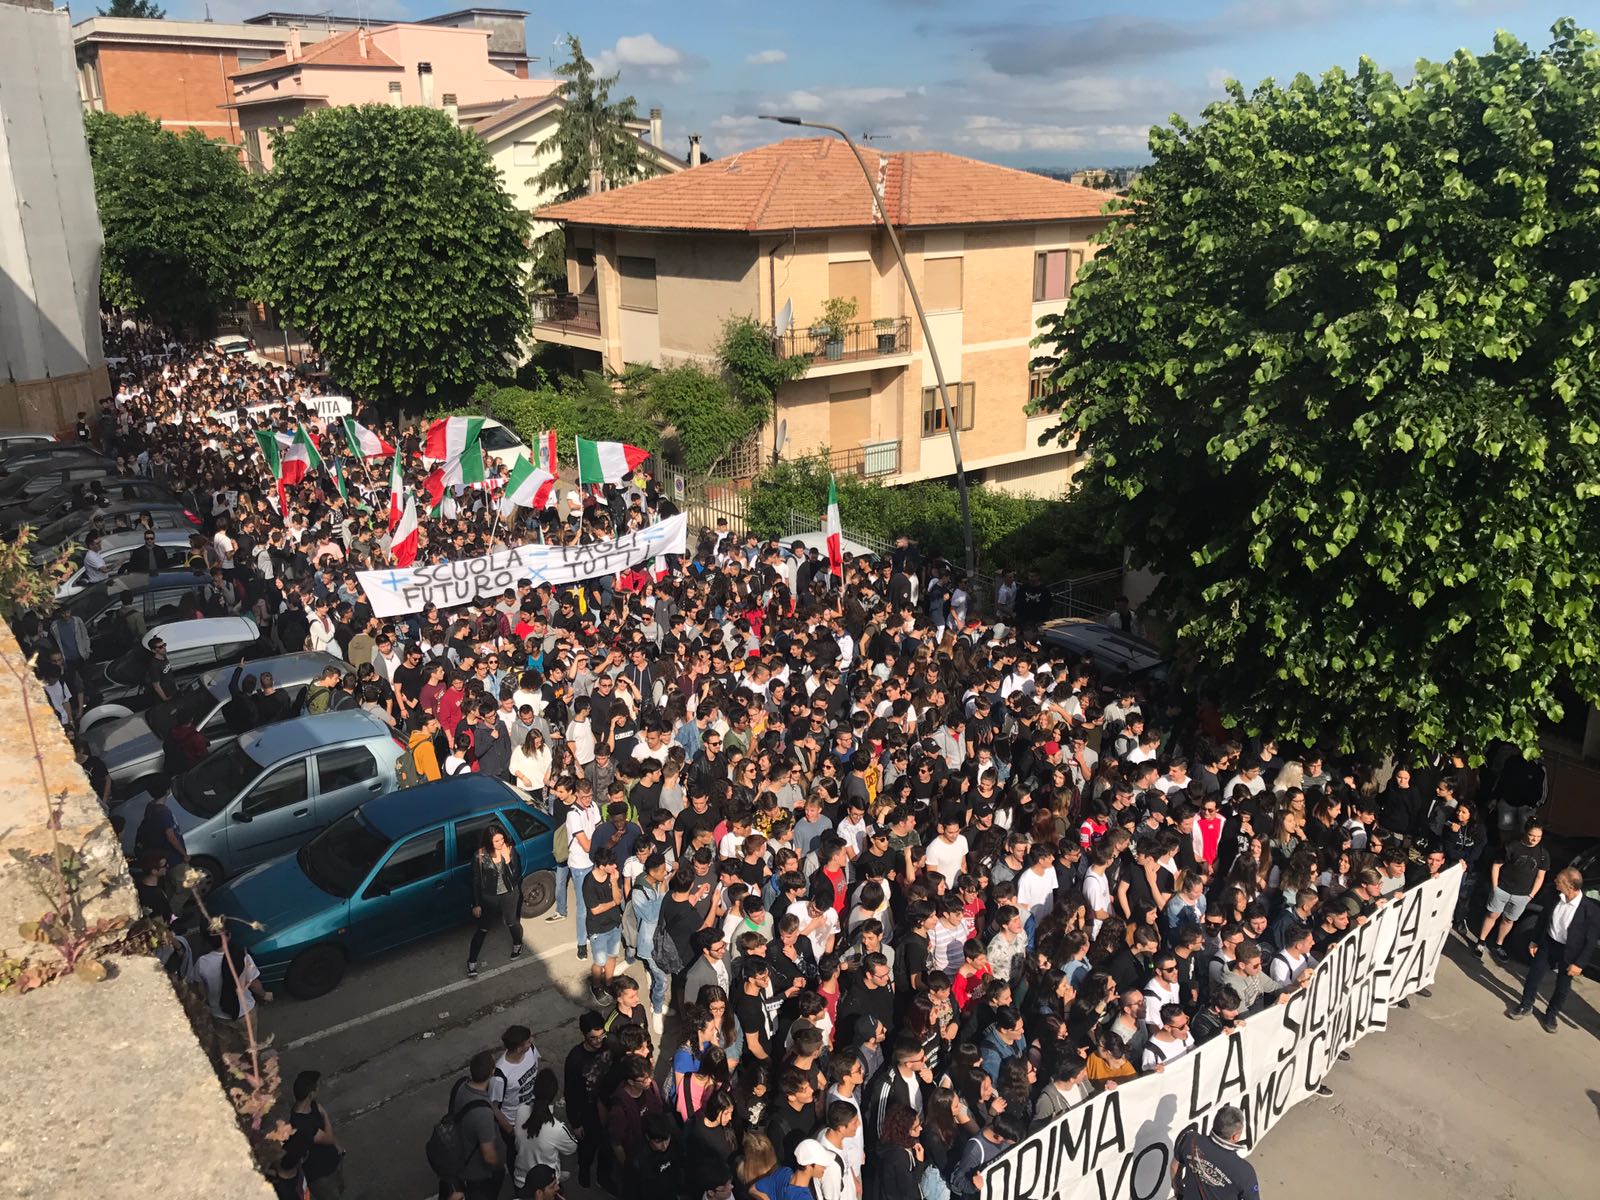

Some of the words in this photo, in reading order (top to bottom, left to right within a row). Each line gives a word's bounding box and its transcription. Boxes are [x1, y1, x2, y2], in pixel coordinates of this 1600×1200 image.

[313, 400, 341, 414] VITA
[413, 550, 523, 587] SCUOLA
[551, 532, 637, 562] TAGLI
[402, 571, 513, 608] FUTURO
[986, 1091, 1126, 1200] PRIMA
[1189, 1032, 1247, 1119] LA
